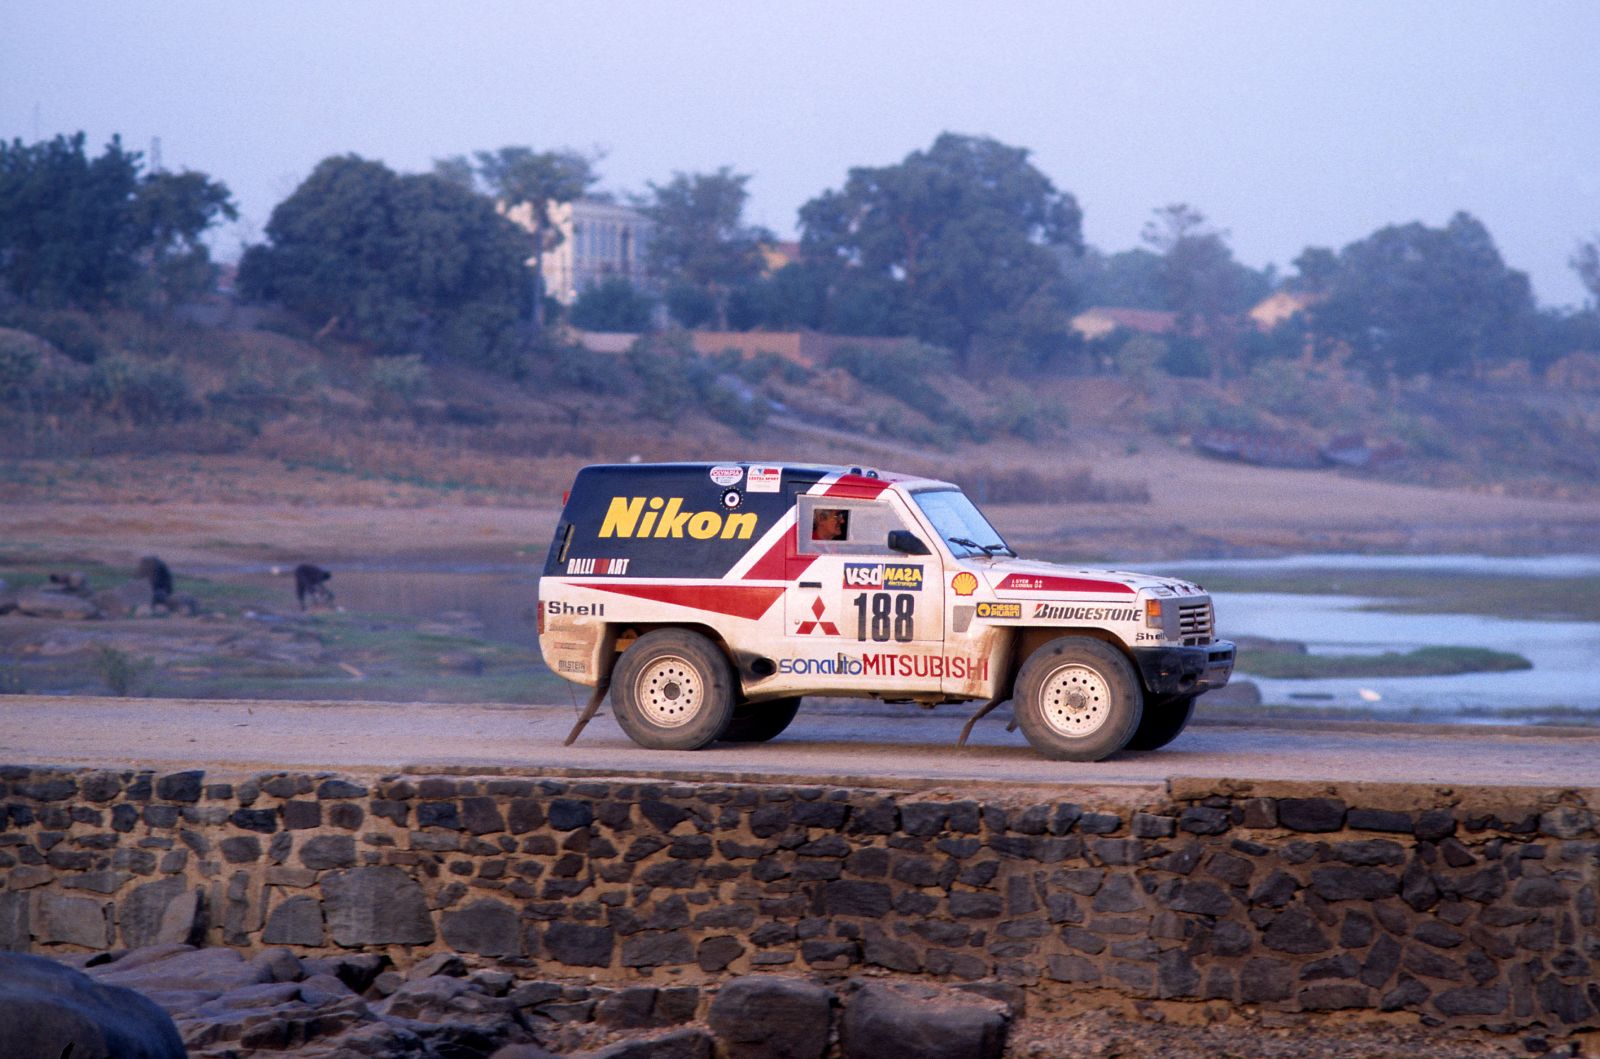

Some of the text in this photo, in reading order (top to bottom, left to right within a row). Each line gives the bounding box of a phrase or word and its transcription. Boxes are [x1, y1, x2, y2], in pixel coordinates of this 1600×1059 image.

[598, 496, 758, 539] Nikon
[567, 558, 630, 575] RALLI ART
[547, 600, 605, 617] Shell
[853, 592, 915, 642] 188
[1032, 602, 1143, 622] BRIDGESTONE
[778, 655, 862, 675] sonauto
[862, 653, 988, 682] MITSUBISHI
